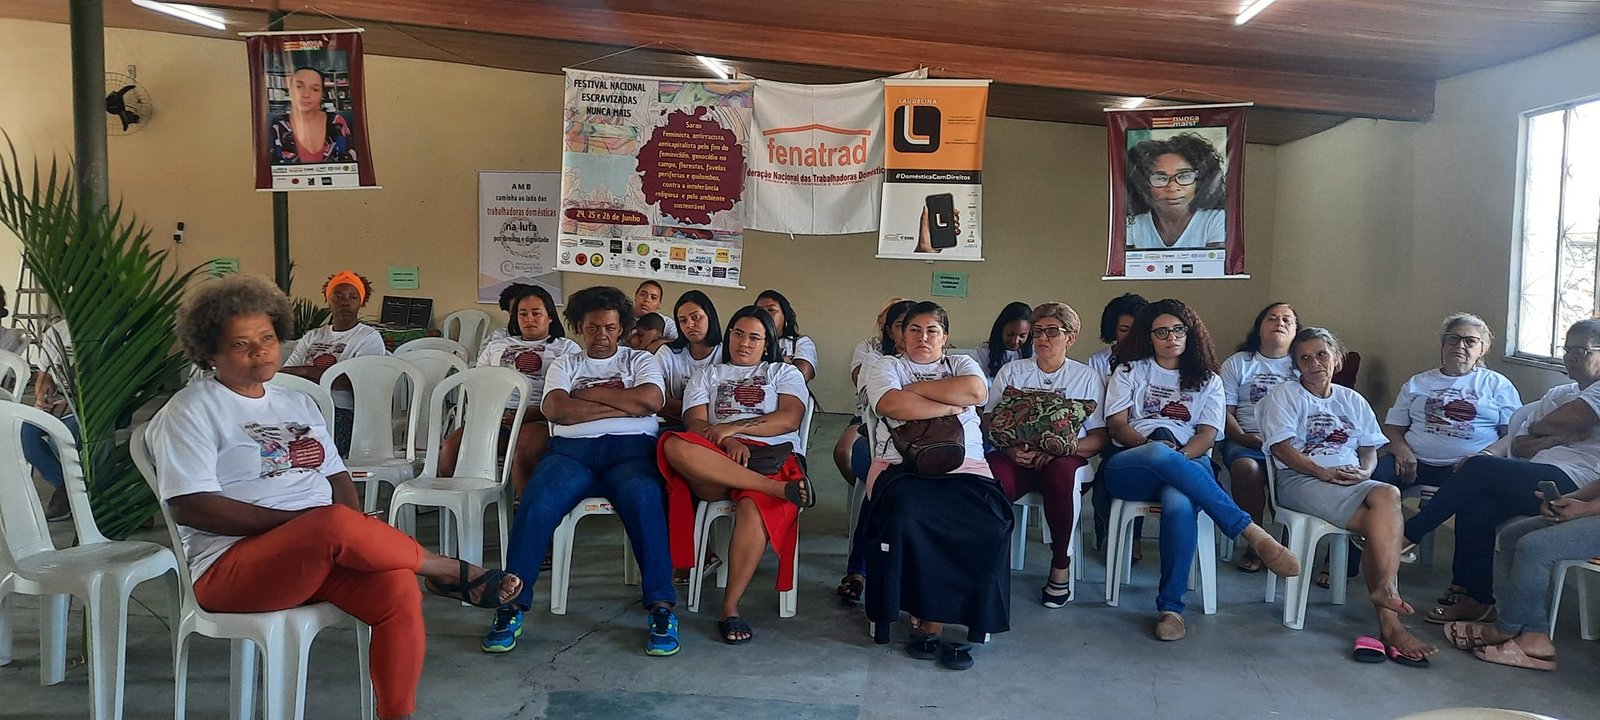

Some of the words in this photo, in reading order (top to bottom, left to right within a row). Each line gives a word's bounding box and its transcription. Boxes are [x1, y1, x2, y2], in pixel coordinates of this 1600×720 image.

[574, 80, 608, 90] FESTIVAL
[610, 82, 646, 92] NACIONAL
[582, 93, 638, 104] ESCRAVIZADAS
[586, 106, 610, 116] NUNCA
[613, 108, 632, 118] MAIS
[662, 130, 691, 139] Feminista,
[658, 141, 696, 149] anticapitalista
[767, 137, 867, 167] fenatrad
[658, 171, 685, 179] periferias
[747, 168, 772, 178] deração
[773, 171, 799, 182] Nacional
[800, 174, 811, 182] das
[813, 173, 857, 183] Trabalhadoras
[487, 207, 524, 216] trabalhadoras
[525, 208, 556, 217] domésticas
[576, 210, 586, 218] 24,
[506, 223, 516, 231] na
[520, 222, 537, 231] luta
